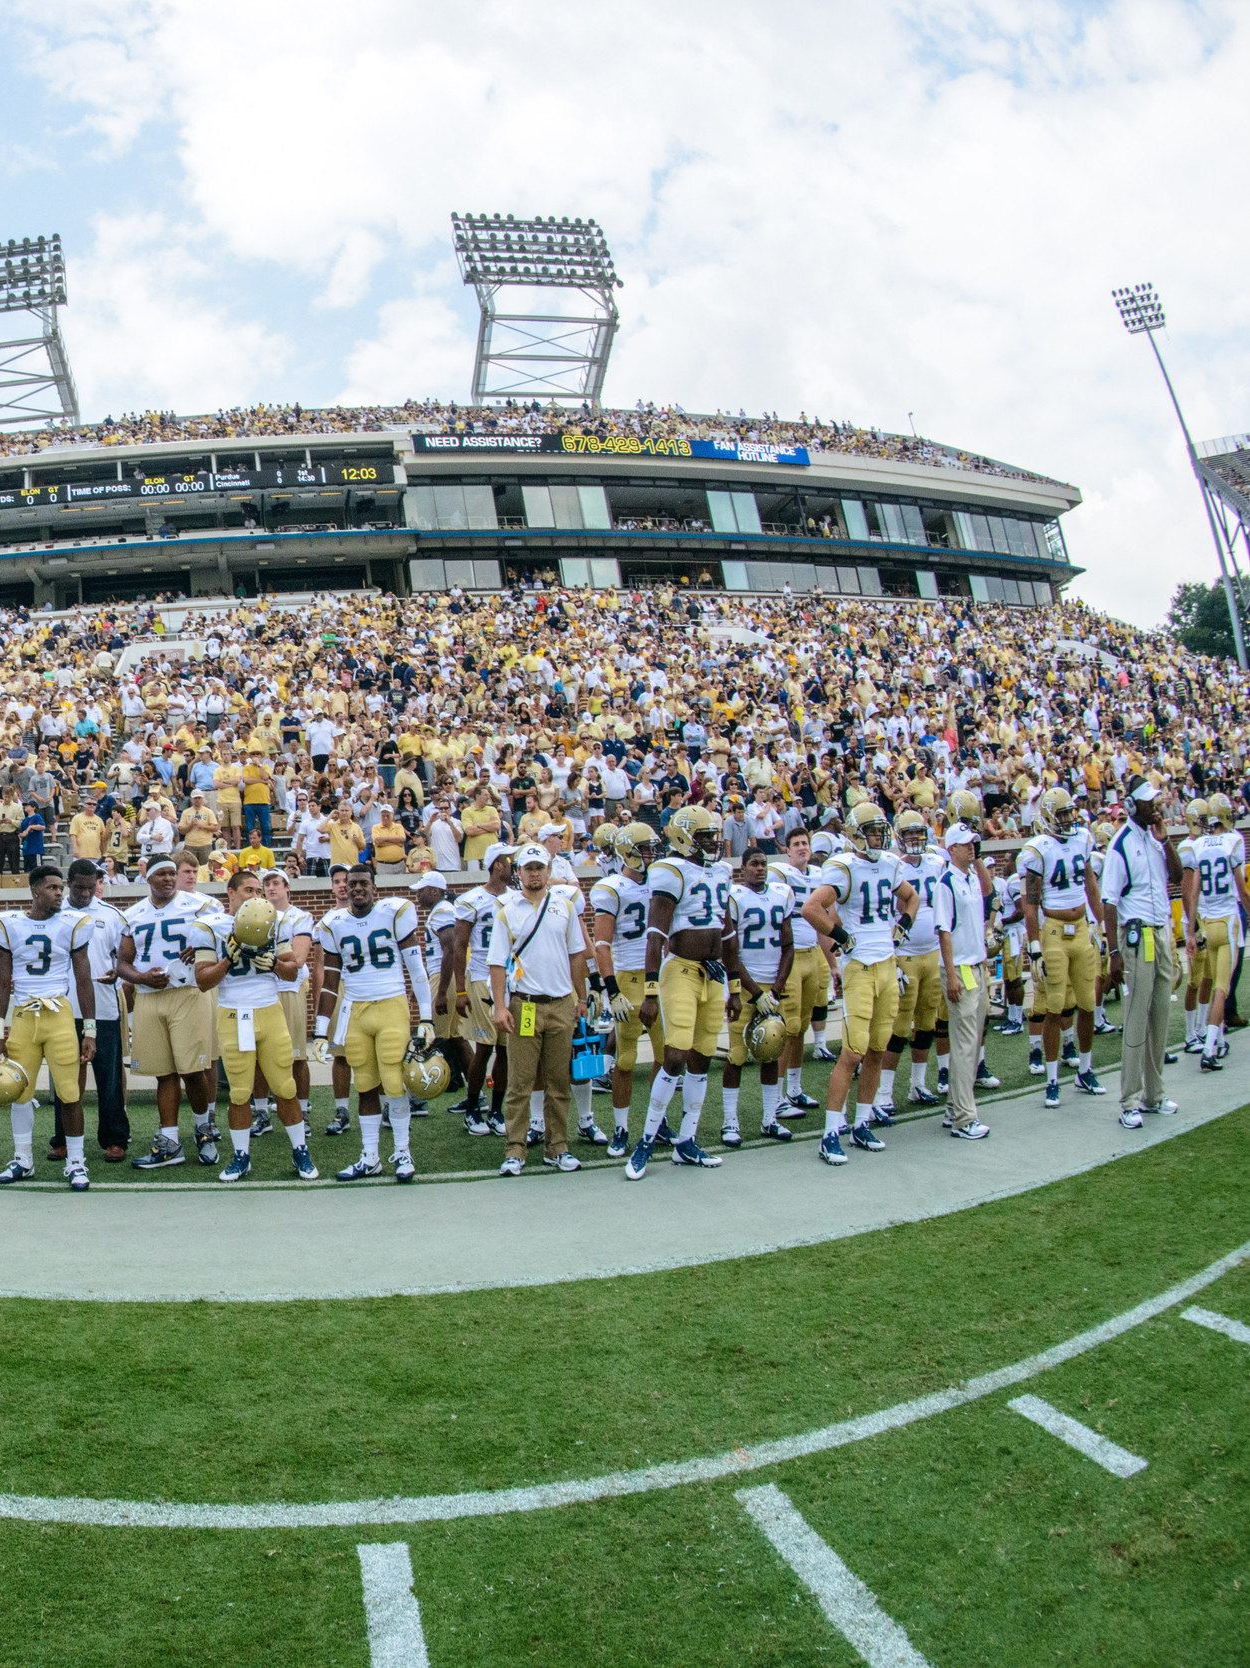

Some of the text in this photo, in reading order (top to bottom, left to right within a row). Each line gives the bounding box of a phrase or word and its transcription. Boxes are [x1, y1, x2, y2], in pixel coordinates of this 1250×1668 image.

[425, 436, 542, 448] NEED ASSISTANCE?
[561, 434, 693, 456] 678-429-1413
[714, 440, 796, 456] FAN ASSISTANCE
[736, 450, 779, 463] HOTLINE
[341, 468, 377, 480] 12:03
[144, 477, 165, 485] ELON
[175, 481, 204, 492] 00:00
[216, 479, 250, 488] Cincinnati
[20, 488, 40, 496] ELON
[48, 486, 60, 494] GT
[71, 484, 132, 496] TIME OF POSS:
[140, 484, 170, 495] 00:00
[26, 495, 34, 505] 0
[50, 493, 58, 503] 0
[1199, 856, 1229, 896] 82
[742, 904, 786, 950] 29
[135, 918, 188, 962] 75
[25, 934, 52, 976] 3
[340, 928, 396, 974] 36
[524, 1018, 532, 1028] 3
